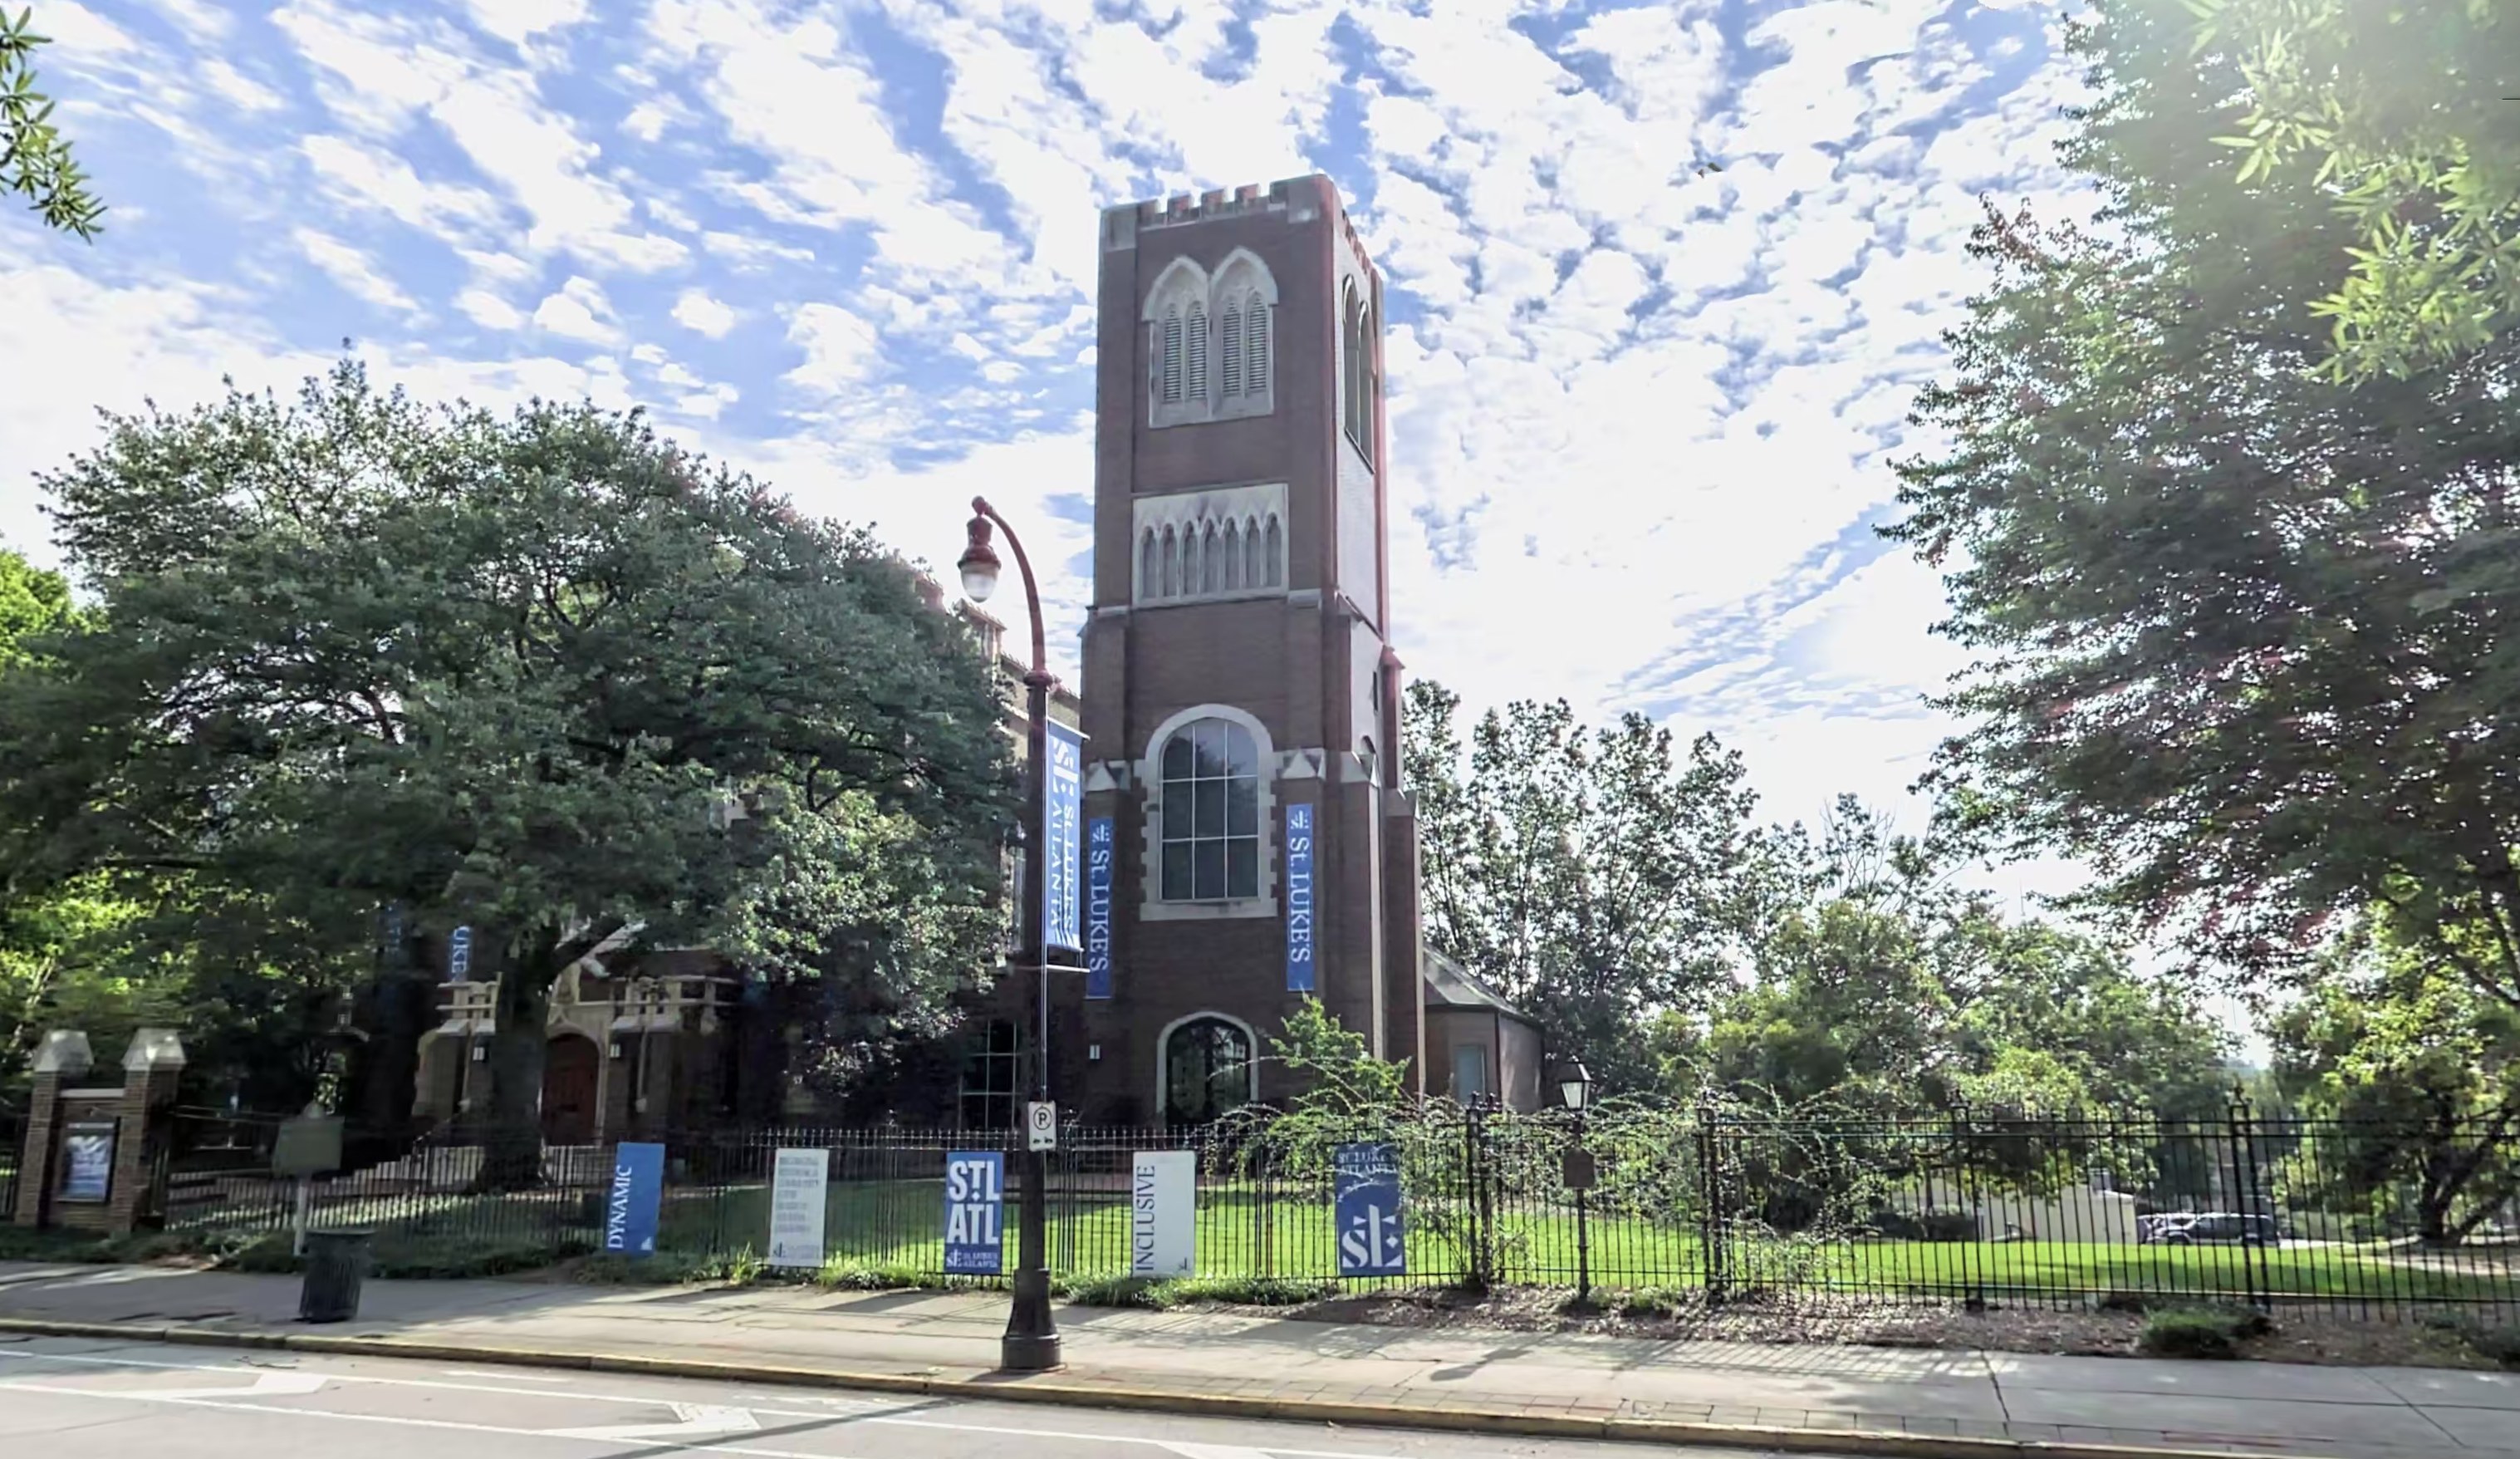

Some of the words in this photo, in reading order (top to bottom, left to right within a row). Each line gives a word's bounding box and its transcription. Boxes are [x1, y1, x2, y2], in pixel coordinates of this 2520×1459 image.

[1051, 801, 1063, 927] ATLANTA
[1091, 849, 1110, 879] St.
[1290, 837, 1310, 867] St.
[1090, 885, 1110, 972] LUKE'S
[1290, 872, 1311, 963] LUKE'S
[607, 1164, 632, 1249] DYNAMIC
[947, 1203, 999, 1245] ATL
[1136, 1166, 1155, 1270] INCLUSIVE
